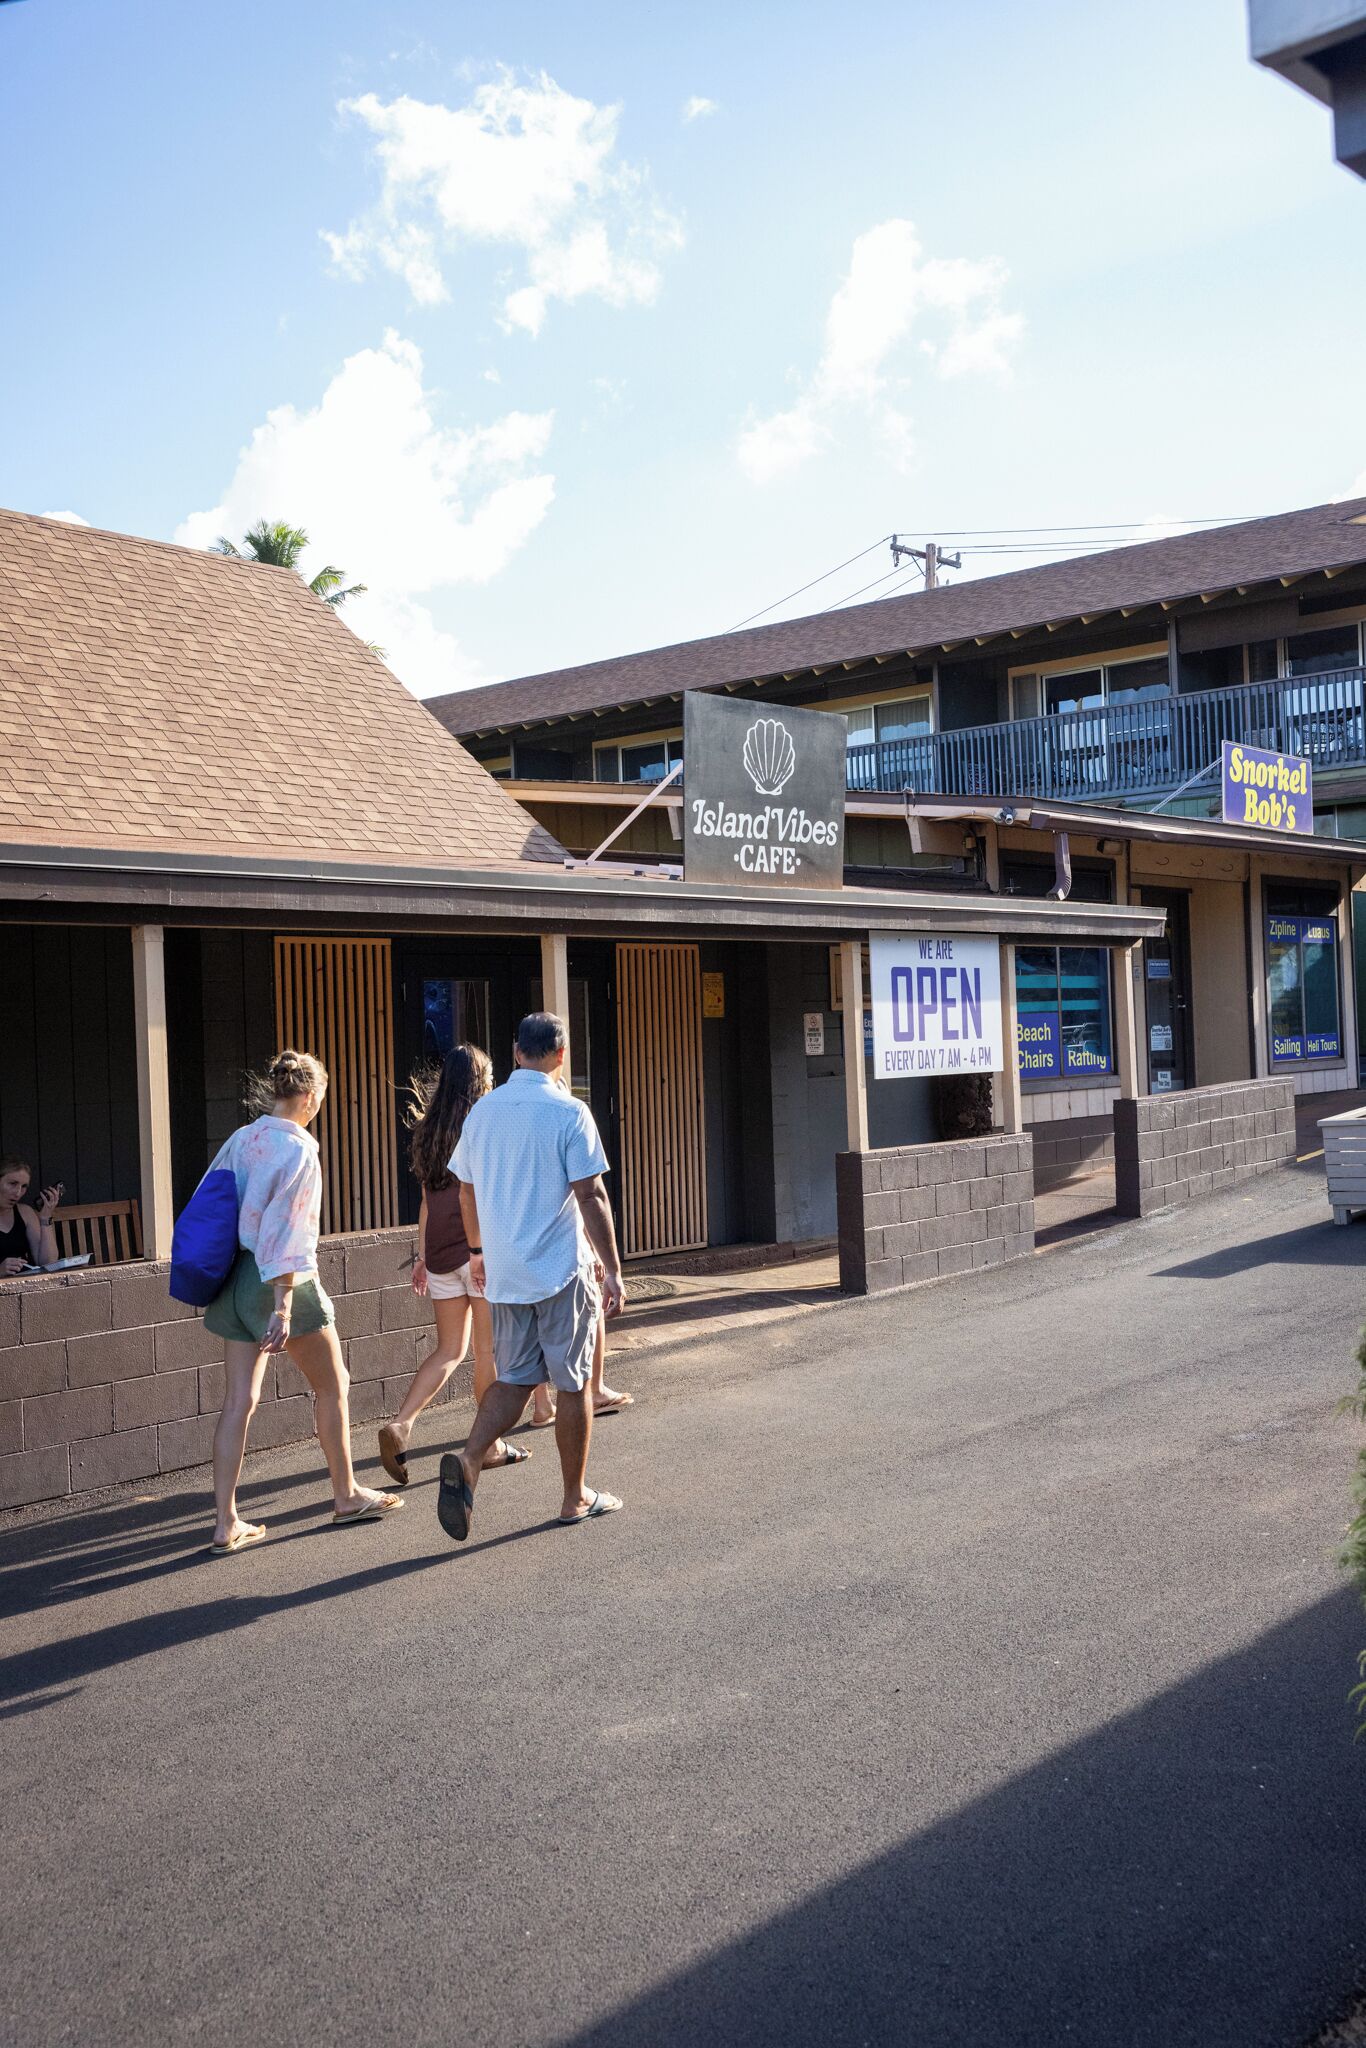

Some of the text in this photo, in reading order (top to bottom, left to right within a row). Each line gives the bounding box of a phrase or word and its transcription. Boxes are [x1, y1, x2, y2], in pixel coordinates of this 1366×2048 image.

[1229, 747, 1308, 795] Snorkel
[1243, 788, 1296, 830] Bob's
[692, 799, 839, 846] Island Vibes
[739, 844, 796, 875] CAFE
[1269, 919, 1297, 940] Zipline
[1307, 922, 1331, 939] Luaus
[918, 939, 953, 960] WE ARE
[890, 966, 983, 1043] OPEN
[1016, 1022, 1052, 1042] Beach
[1273, 1039, 1301, 1057] Sailing
[1307, 1038, 1338, 1053] Heli Tours
[885, 1049, 915, 1072] EVERY
[918, 1048, 936, 1070] DAY
[938, 1048, 945, 1069] 7
[947, 1047, 961, 1068] AM
[969, 1047, 976, 1067] 4
[978, 1046, 992, 1066] PM
[1017, 1049, 1054, 1070] Chairs
